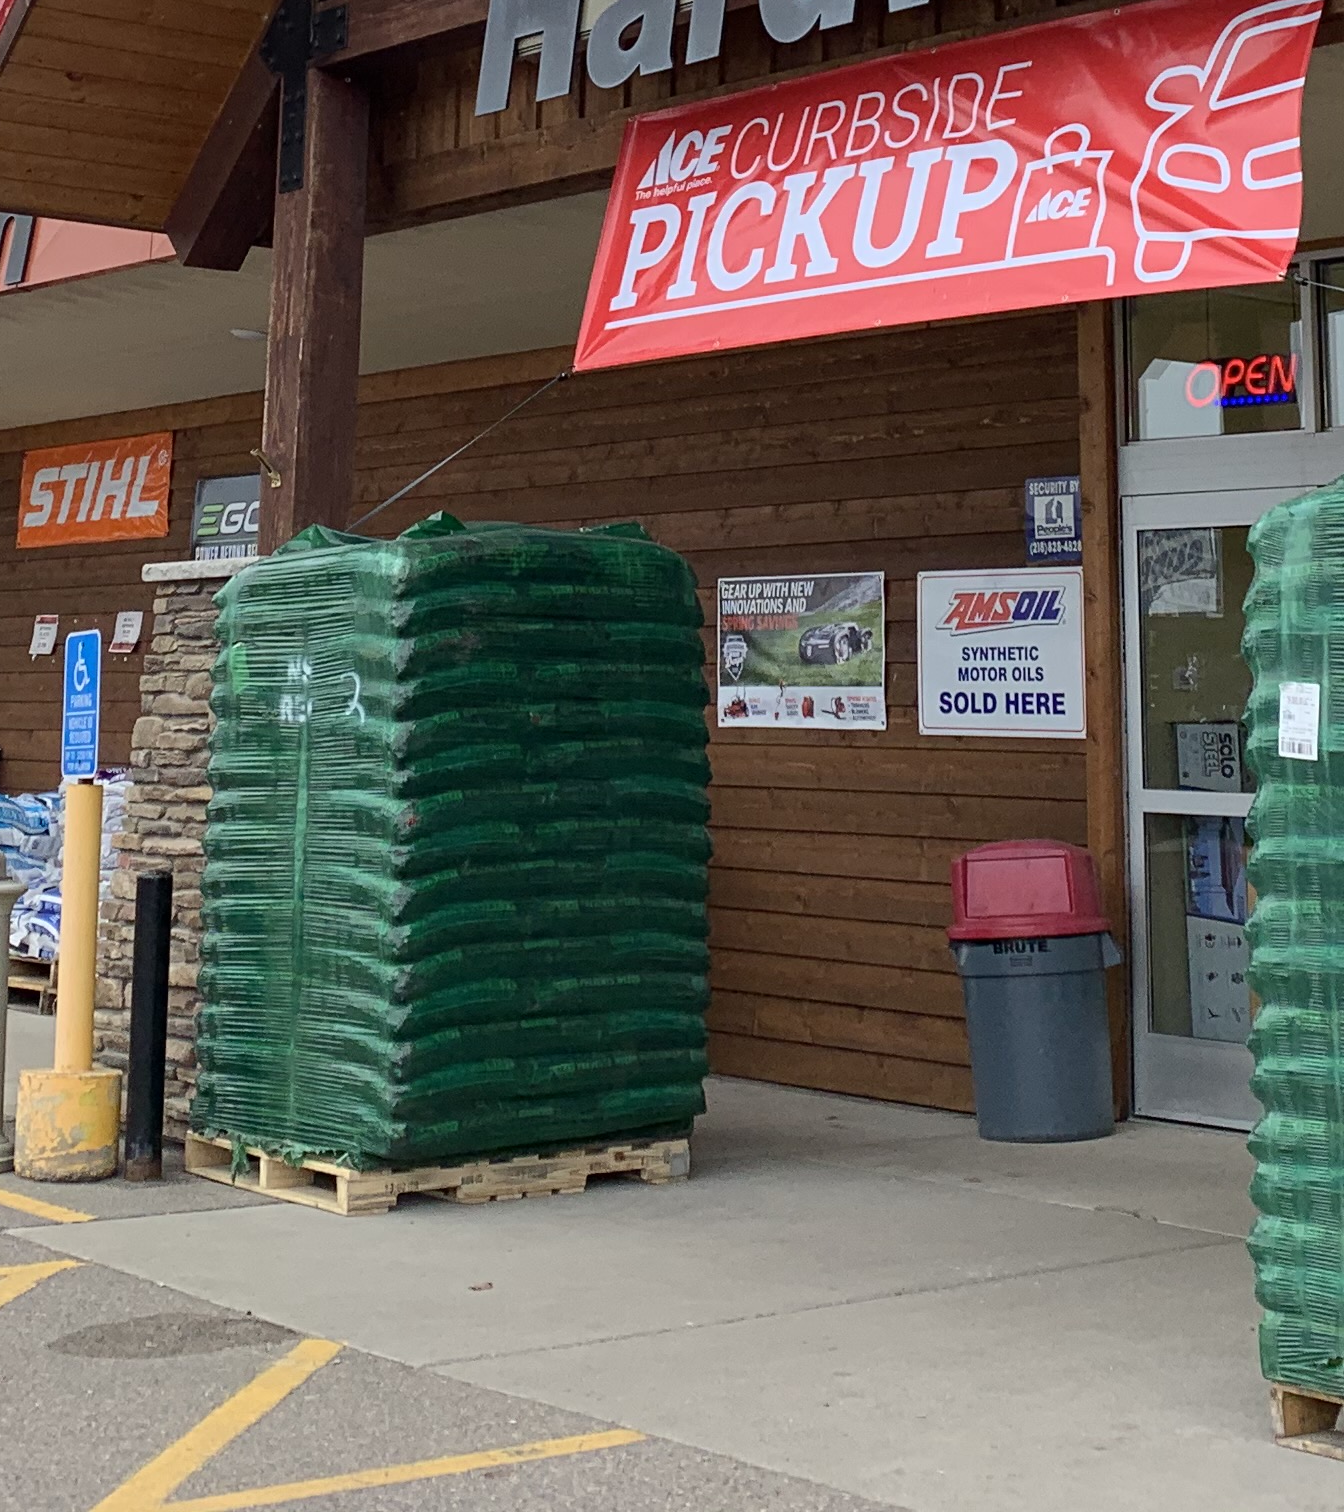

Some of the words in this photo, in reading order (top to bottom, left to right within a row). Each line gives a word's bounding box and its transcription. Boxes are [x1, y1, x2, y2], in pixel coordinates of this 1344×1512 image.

[636, 124, 733, 189] ACE
[730, 60, 1032, 179] CURBSIDE
[635, 190, 651, 201] The
[653, 181, 686, 197] helpful
[1025, 186, 1092, 223] ACE
[609, 139, 1017, 312] PICKUP
[1186, 353, 1298, 408] OPEN
[22, 454, 160, 529] STIHL
[1029, 480, 1067, 496] SECURITY
[1069, 480, 1080, 493] BY
[721, 583, 748, 600] GEAR
[748, 582, 761, 598] UP
[763, 581, 789, 597] WITH
[790, 580, 814, 596] NEW
[721, 599, 784, 615] INNOVATIONS
[785, 598, 807, 613] AND
[942, 590, 1063, 632] AMSOIL
[722, 614, 755, 631] SPRING
[759, 614, 799, 631] SAVINGS
[961, 646, 1039, 662] SYNTHETIC
[958, 667, 1007, 682] MOTOR
[1012, 667, 1044, 682] OILS
[939, 691, 997, 715] SOLD
[1005, 692, 1066, 716] HERE
[992, 939, 1048, 955] BRUTE
